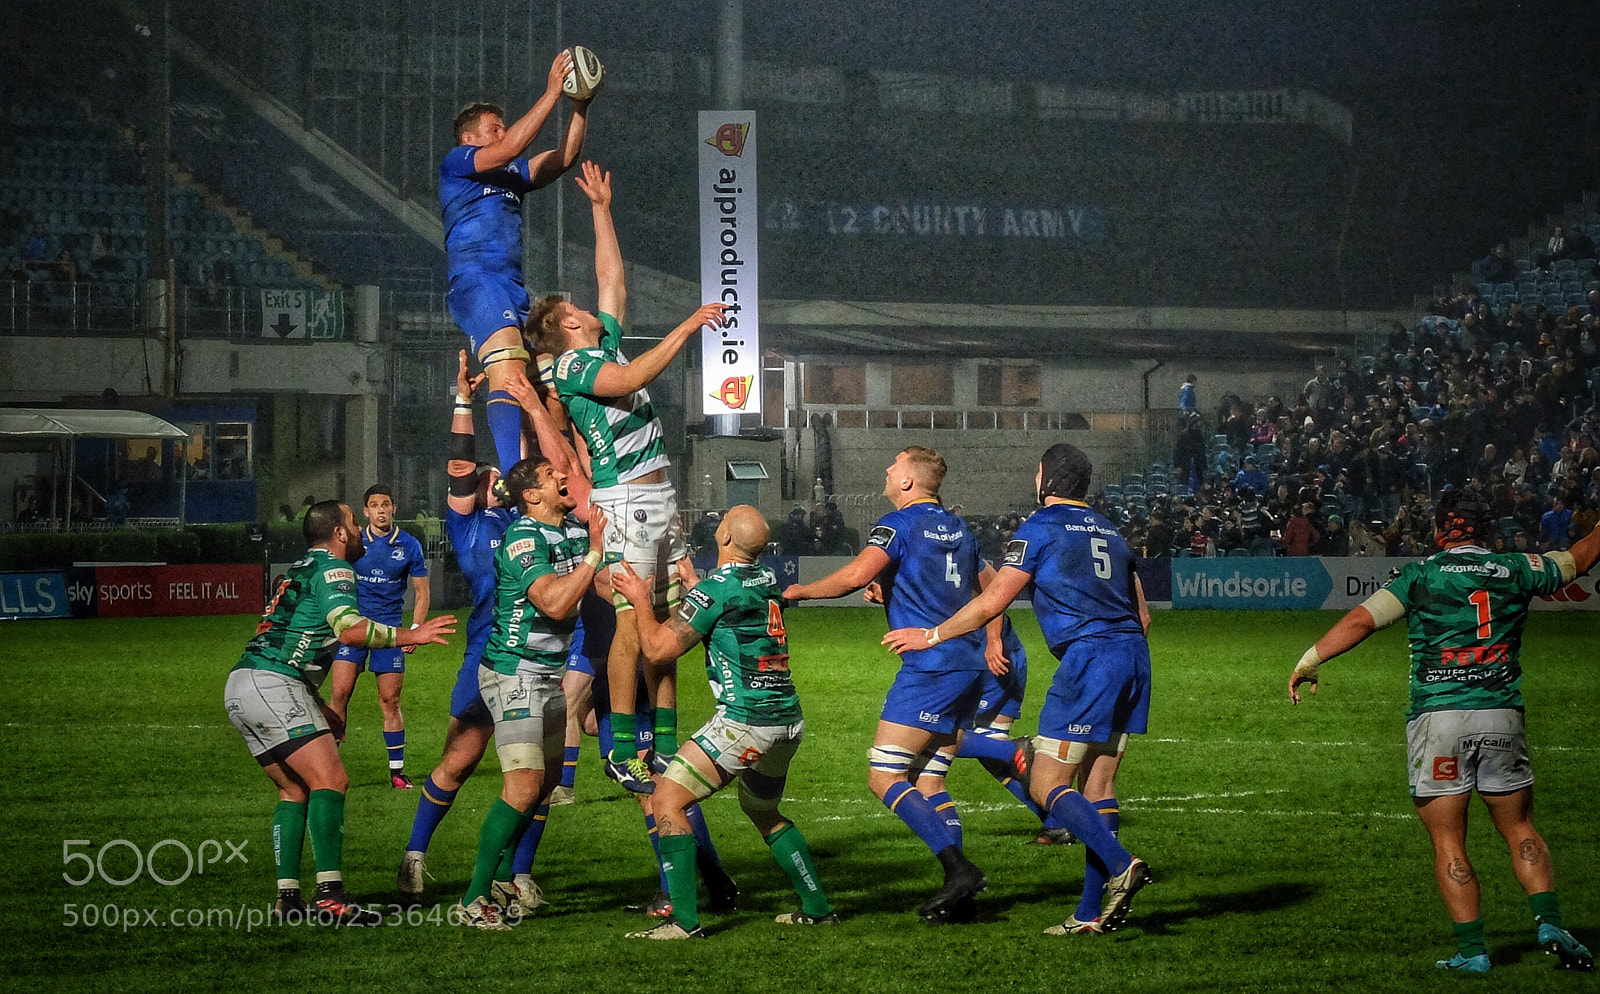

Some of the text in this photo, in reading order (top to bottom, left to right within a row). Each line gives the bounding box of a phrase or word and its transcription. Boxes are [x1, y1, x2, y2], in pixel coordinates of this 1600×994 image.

[1003, 207, 1084, 238] ARMY
[713, 168, 744, 365] ajproducts.ie
[265, 291, 290, 308] Exit
[1065, 524, 1087, 532] Bank
[945, 552, 961, 588] 4
[1091, 537, 1111, 580] 5
[67, 581, 153, 605] sky sports
[169, 582, 239, 600] FEEL IT ALL
[1175, 571, 1307, 598] Windsor.ie
[766, 600, 786, 646] 4
[1468, 590, 1492, 640] 1
